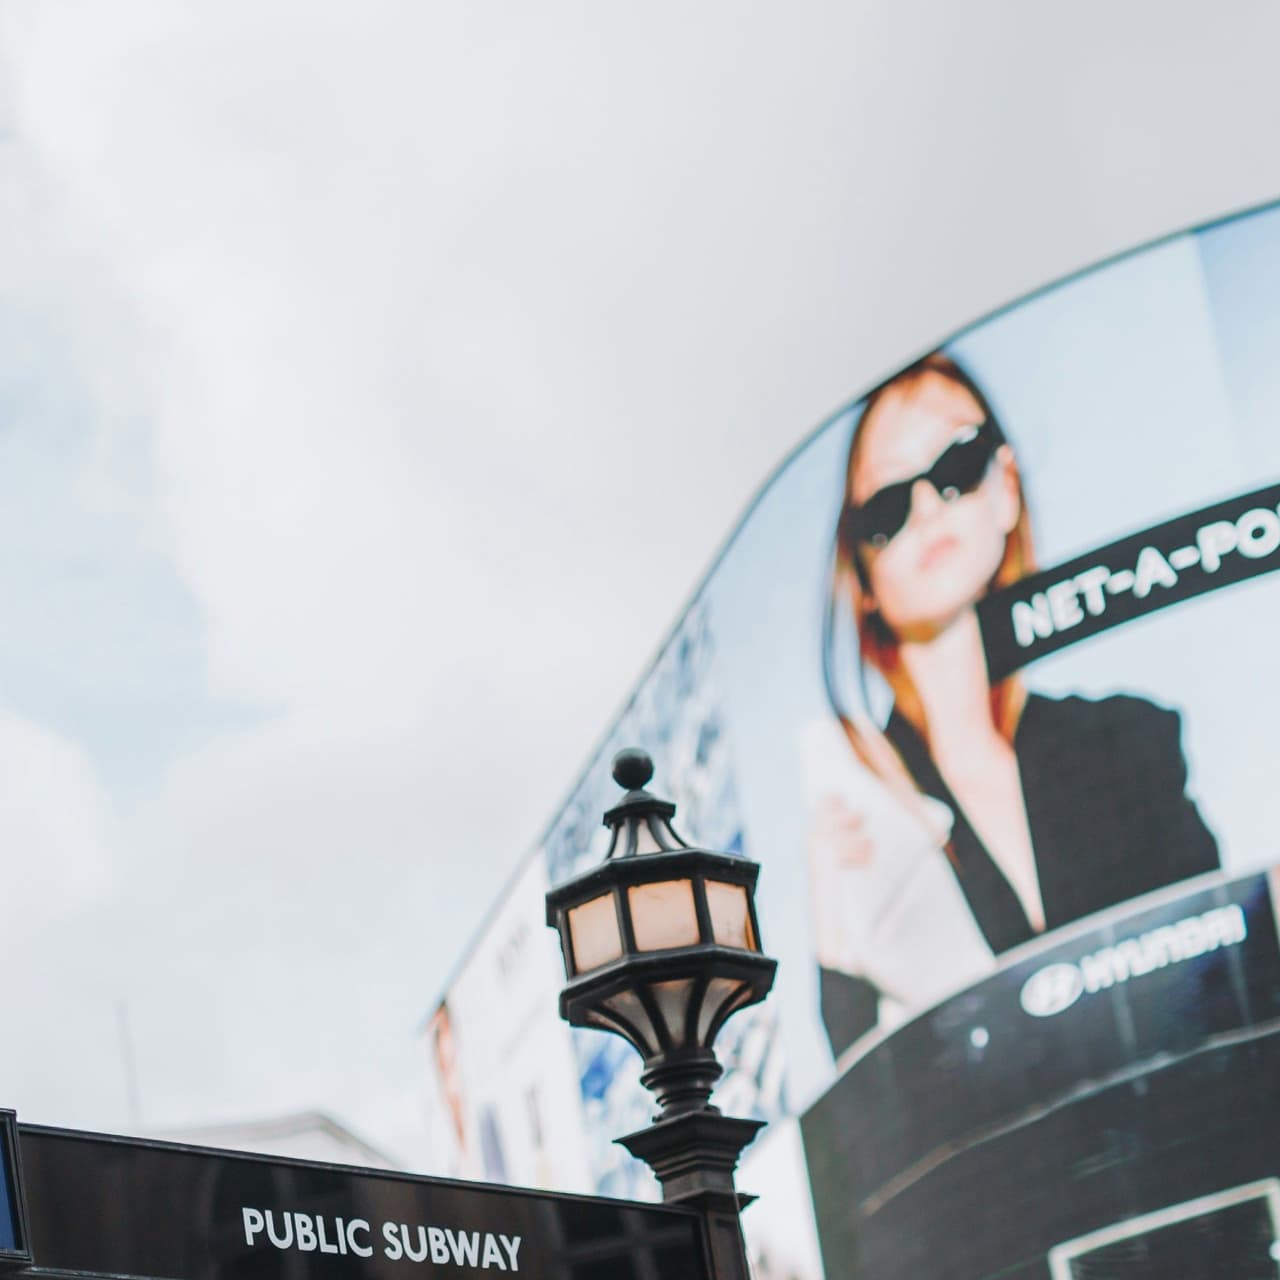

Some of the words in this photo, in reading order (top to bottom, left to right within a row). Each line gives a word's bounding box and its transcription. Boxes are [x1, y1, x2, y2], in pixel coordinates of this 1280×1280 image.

[1081, 903, 1247, 993] HYUNDAI
[242, 1207, 374, 1258] PUBLIC
[382, 1221, 522, 1272] SUBWAY
